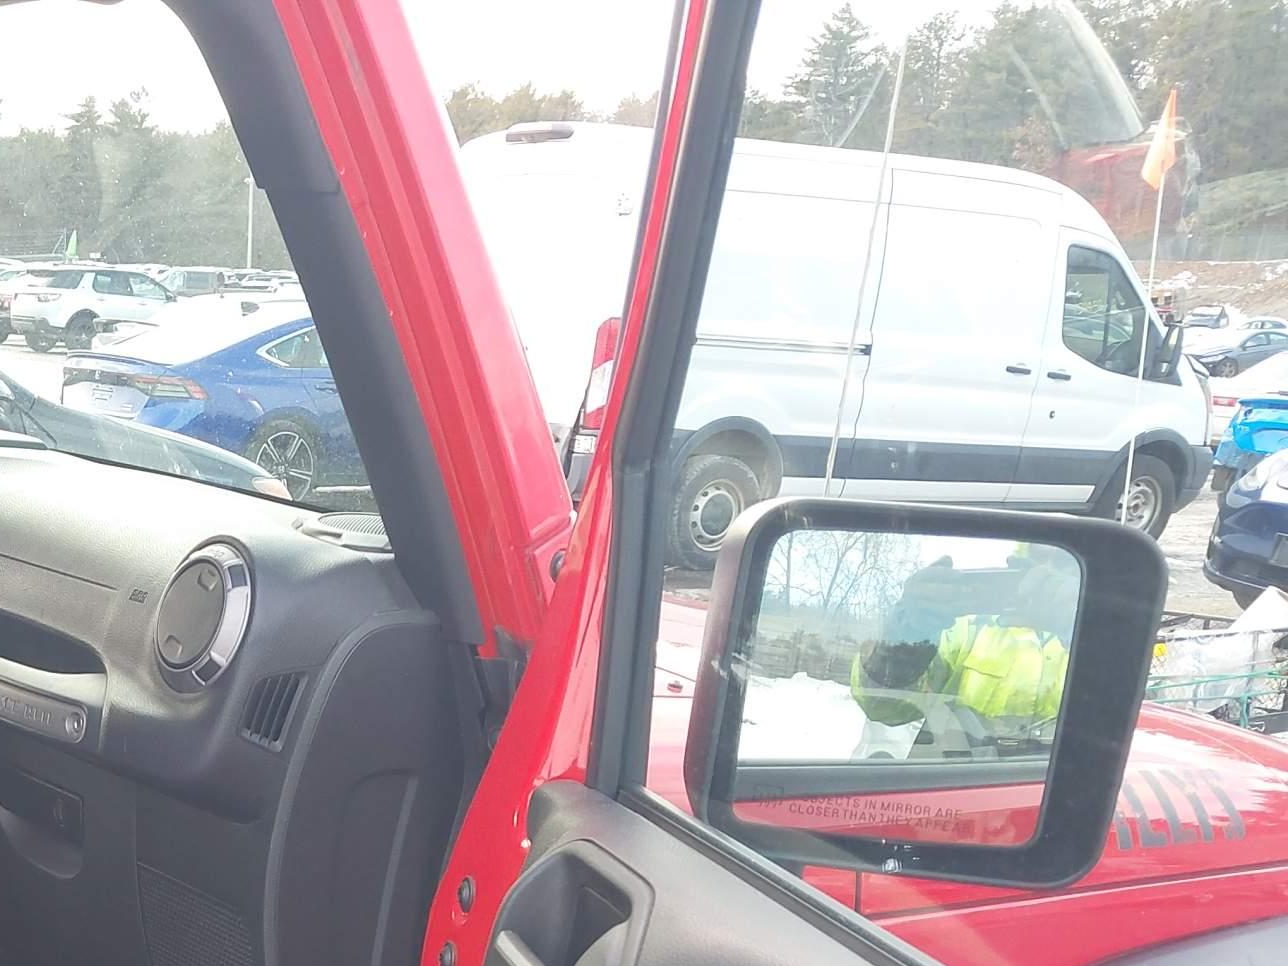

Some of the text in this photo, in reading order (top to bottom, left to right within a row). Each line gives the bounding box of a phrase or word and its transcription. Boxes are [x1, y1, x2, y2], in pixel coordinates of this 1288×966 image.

[788, 803, 839, 819] CLOSER
[843, 808, 877, 823] THAN
[879, 812, 912, 826] THEY
[864, 799, 877, 811] IN
[880, 801, 931, 817] MIRROR
[935, 807, 963, 819] ARE
